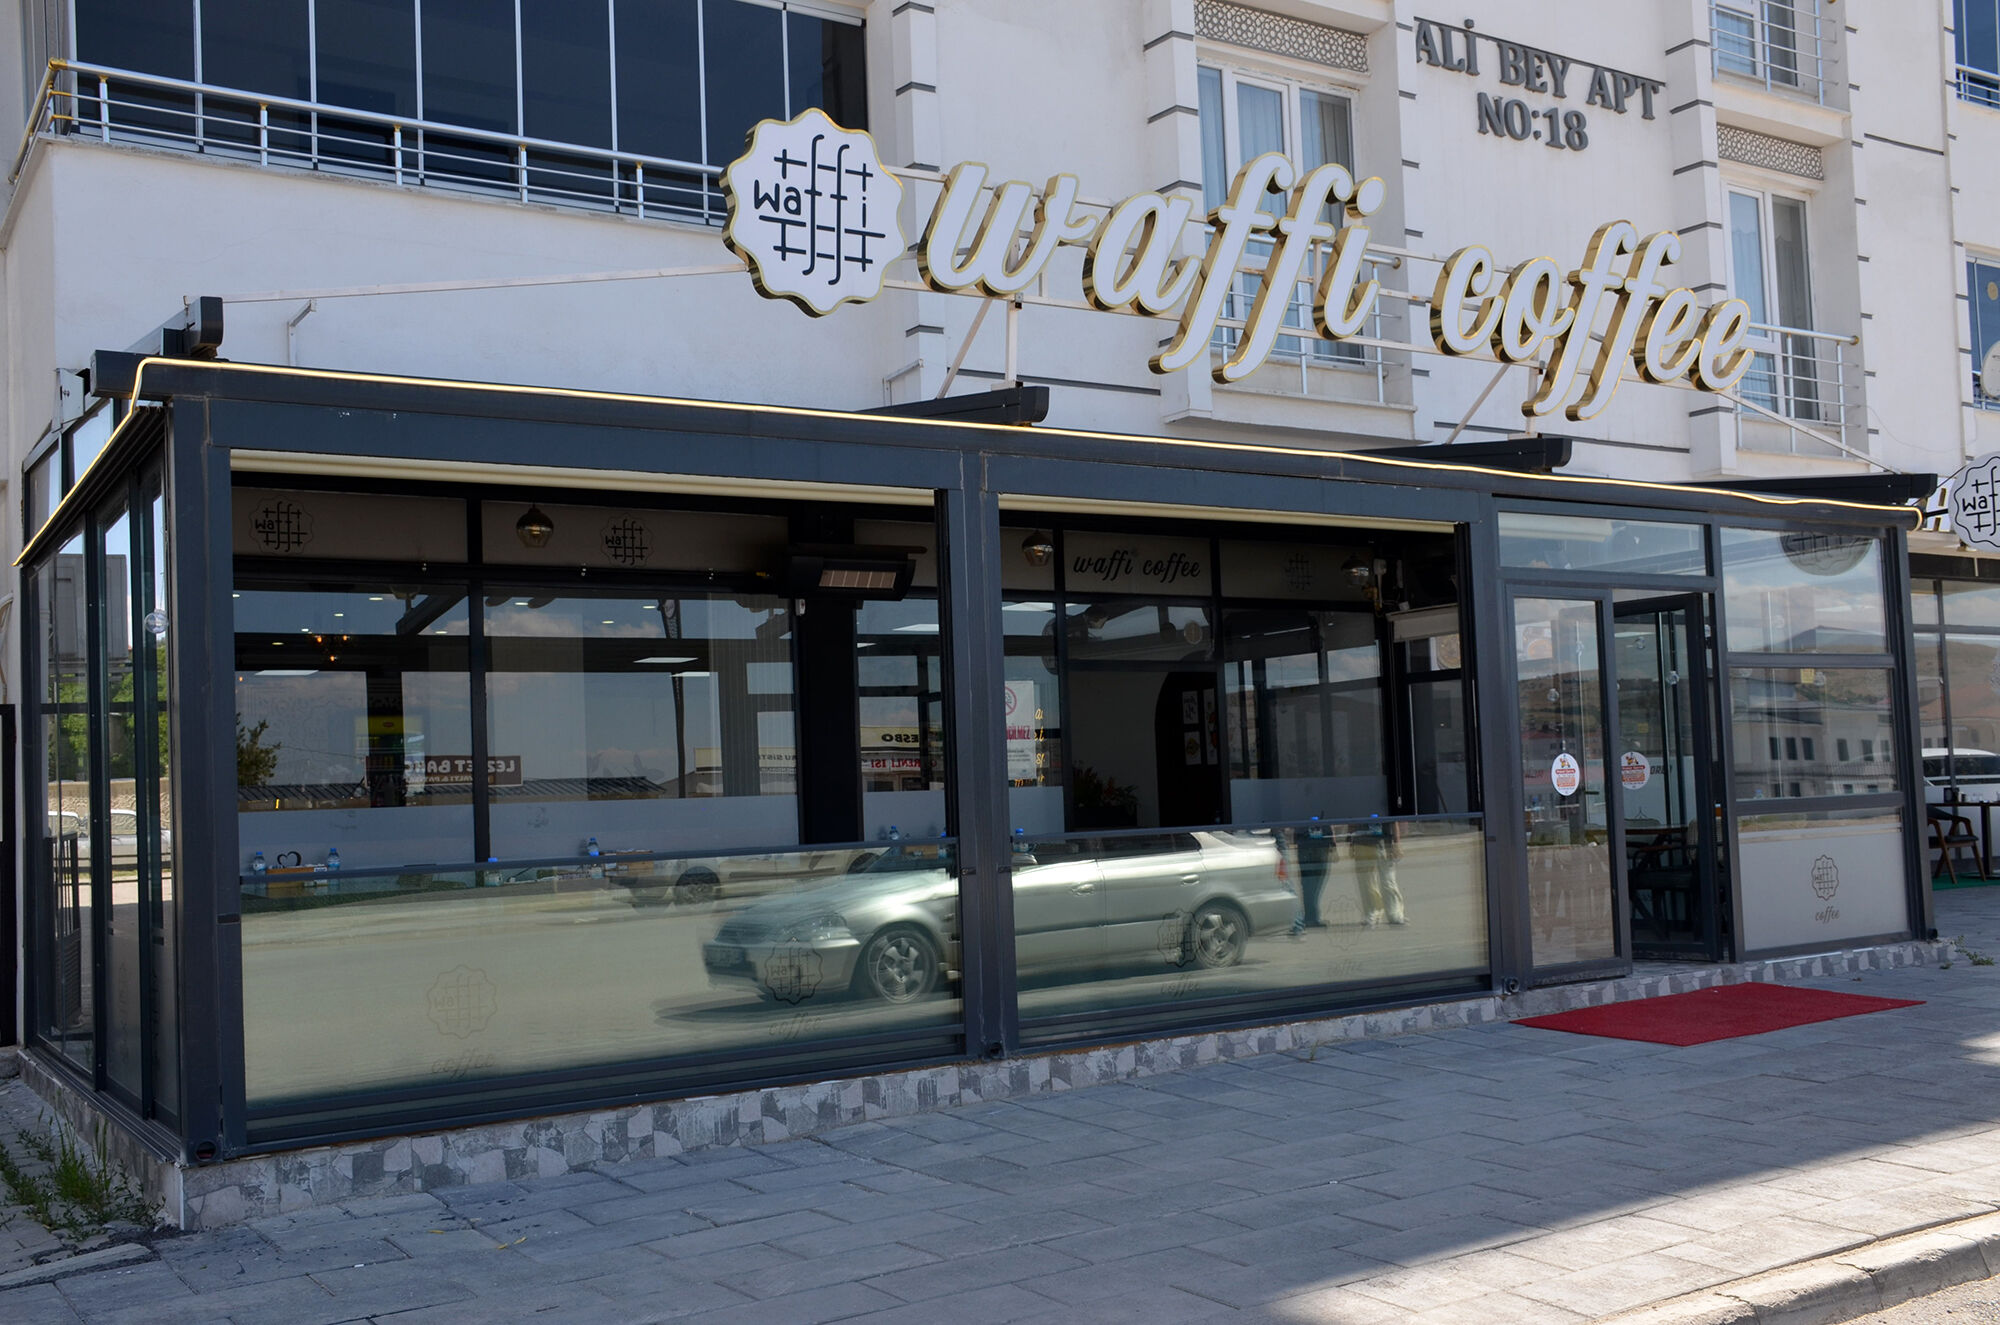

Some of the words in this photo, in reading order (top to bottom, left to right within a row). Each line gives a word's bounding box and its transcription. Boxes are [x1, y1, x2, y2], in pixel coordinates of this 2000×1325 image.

[1415, 18, 1478, 77] ALİ
[1496, 39, 1570, 99] BEY
[1585, 66, 1661, 121] APT
[1476, 90, 1590, 152] NO:18
[917, 151, 1386, 384] waffi
[1429, 218, 1756, 422] coffee
[1073, 549, 1134, 582] waffi
[1142, 552, 1201, 584] coffee
[1814, 905, 1841, 925] coffee
